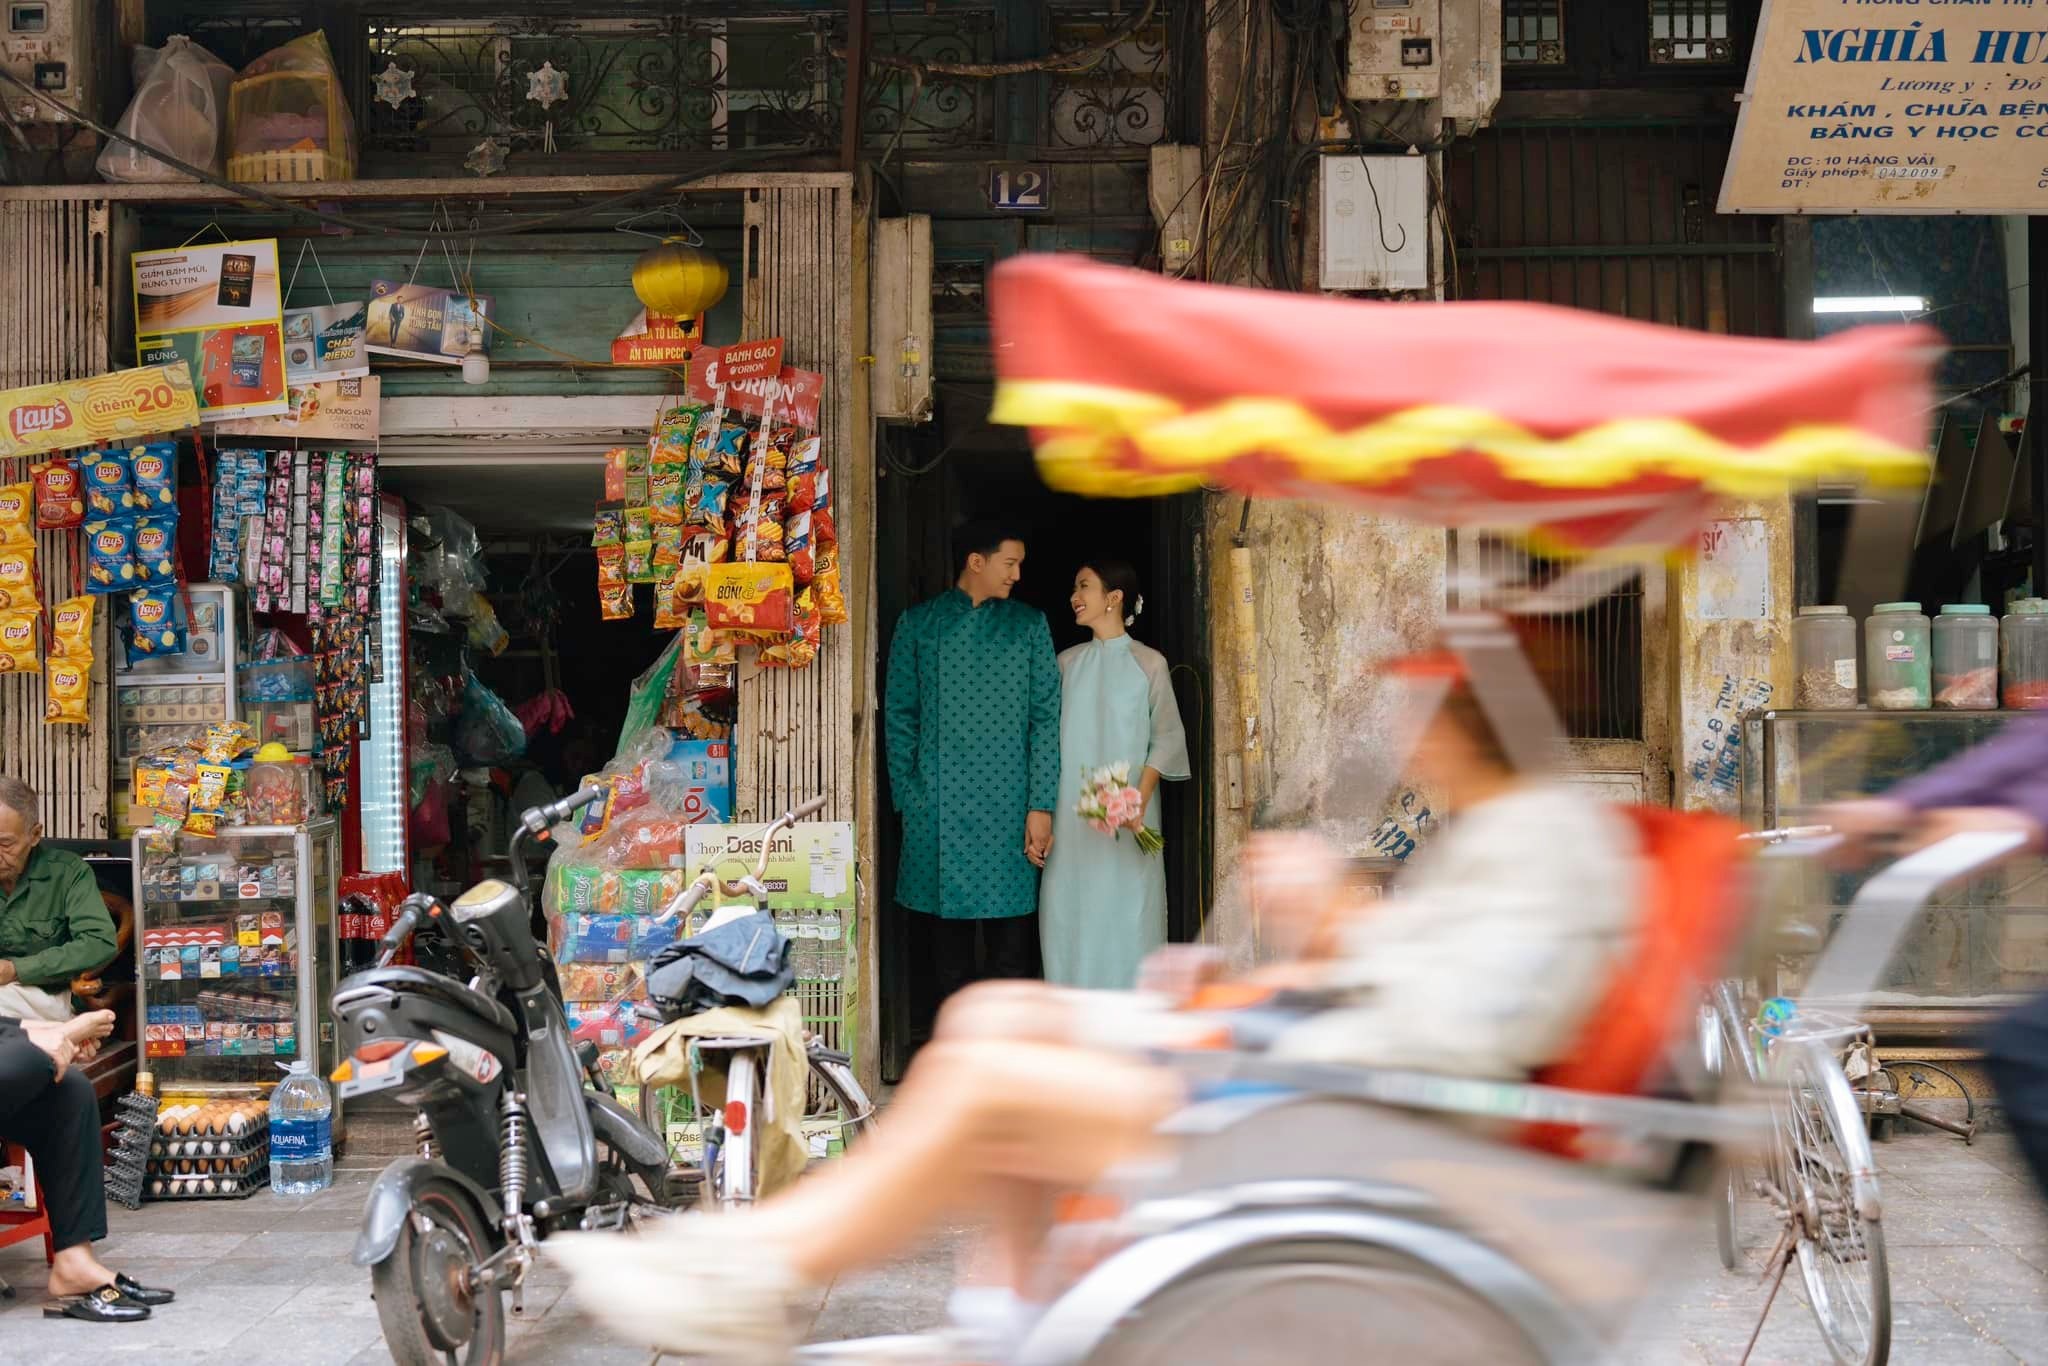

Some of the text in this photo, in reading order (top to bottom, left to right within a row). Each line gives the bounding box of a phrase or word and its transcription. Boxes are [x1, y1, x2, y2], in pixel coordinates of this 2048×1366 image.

[1969, 27, 2048, 64] HU
[1958, 82, 1975, 94] y
[1787, 101, 1876, 117] KHÁM
[1905, 98, 1988, 116] CHỮA
[1908, 126, 1926, 137] Y
[1936, 126, 2000, 141] HỌC
[1826, 157, 1841, 165] 10
[997, 171, 1041, 204] 12
[630, 348, 640, 360] AN
[0, 498, 20, 511] ay's
